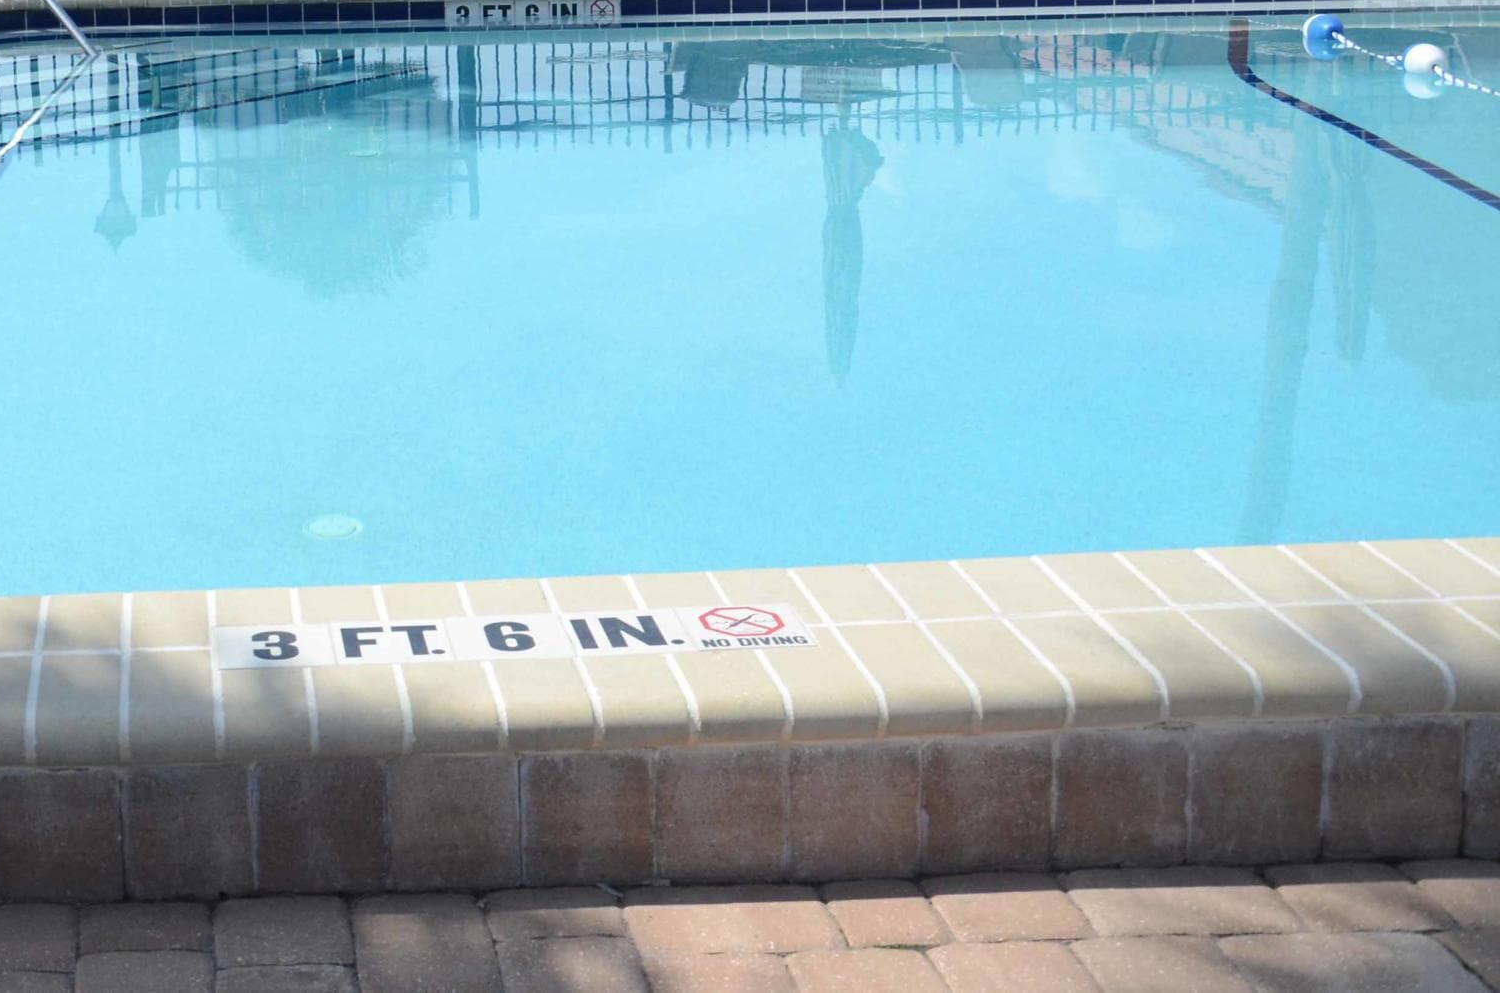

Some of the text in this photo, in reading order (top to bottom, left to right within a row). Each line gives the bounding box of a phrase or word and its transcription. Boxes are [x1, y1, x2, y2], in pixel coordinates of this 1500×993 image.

[251, 615, 685, 661] 3 FT. 6 IN.
[701, 635, 809, 648] NO DIVING
